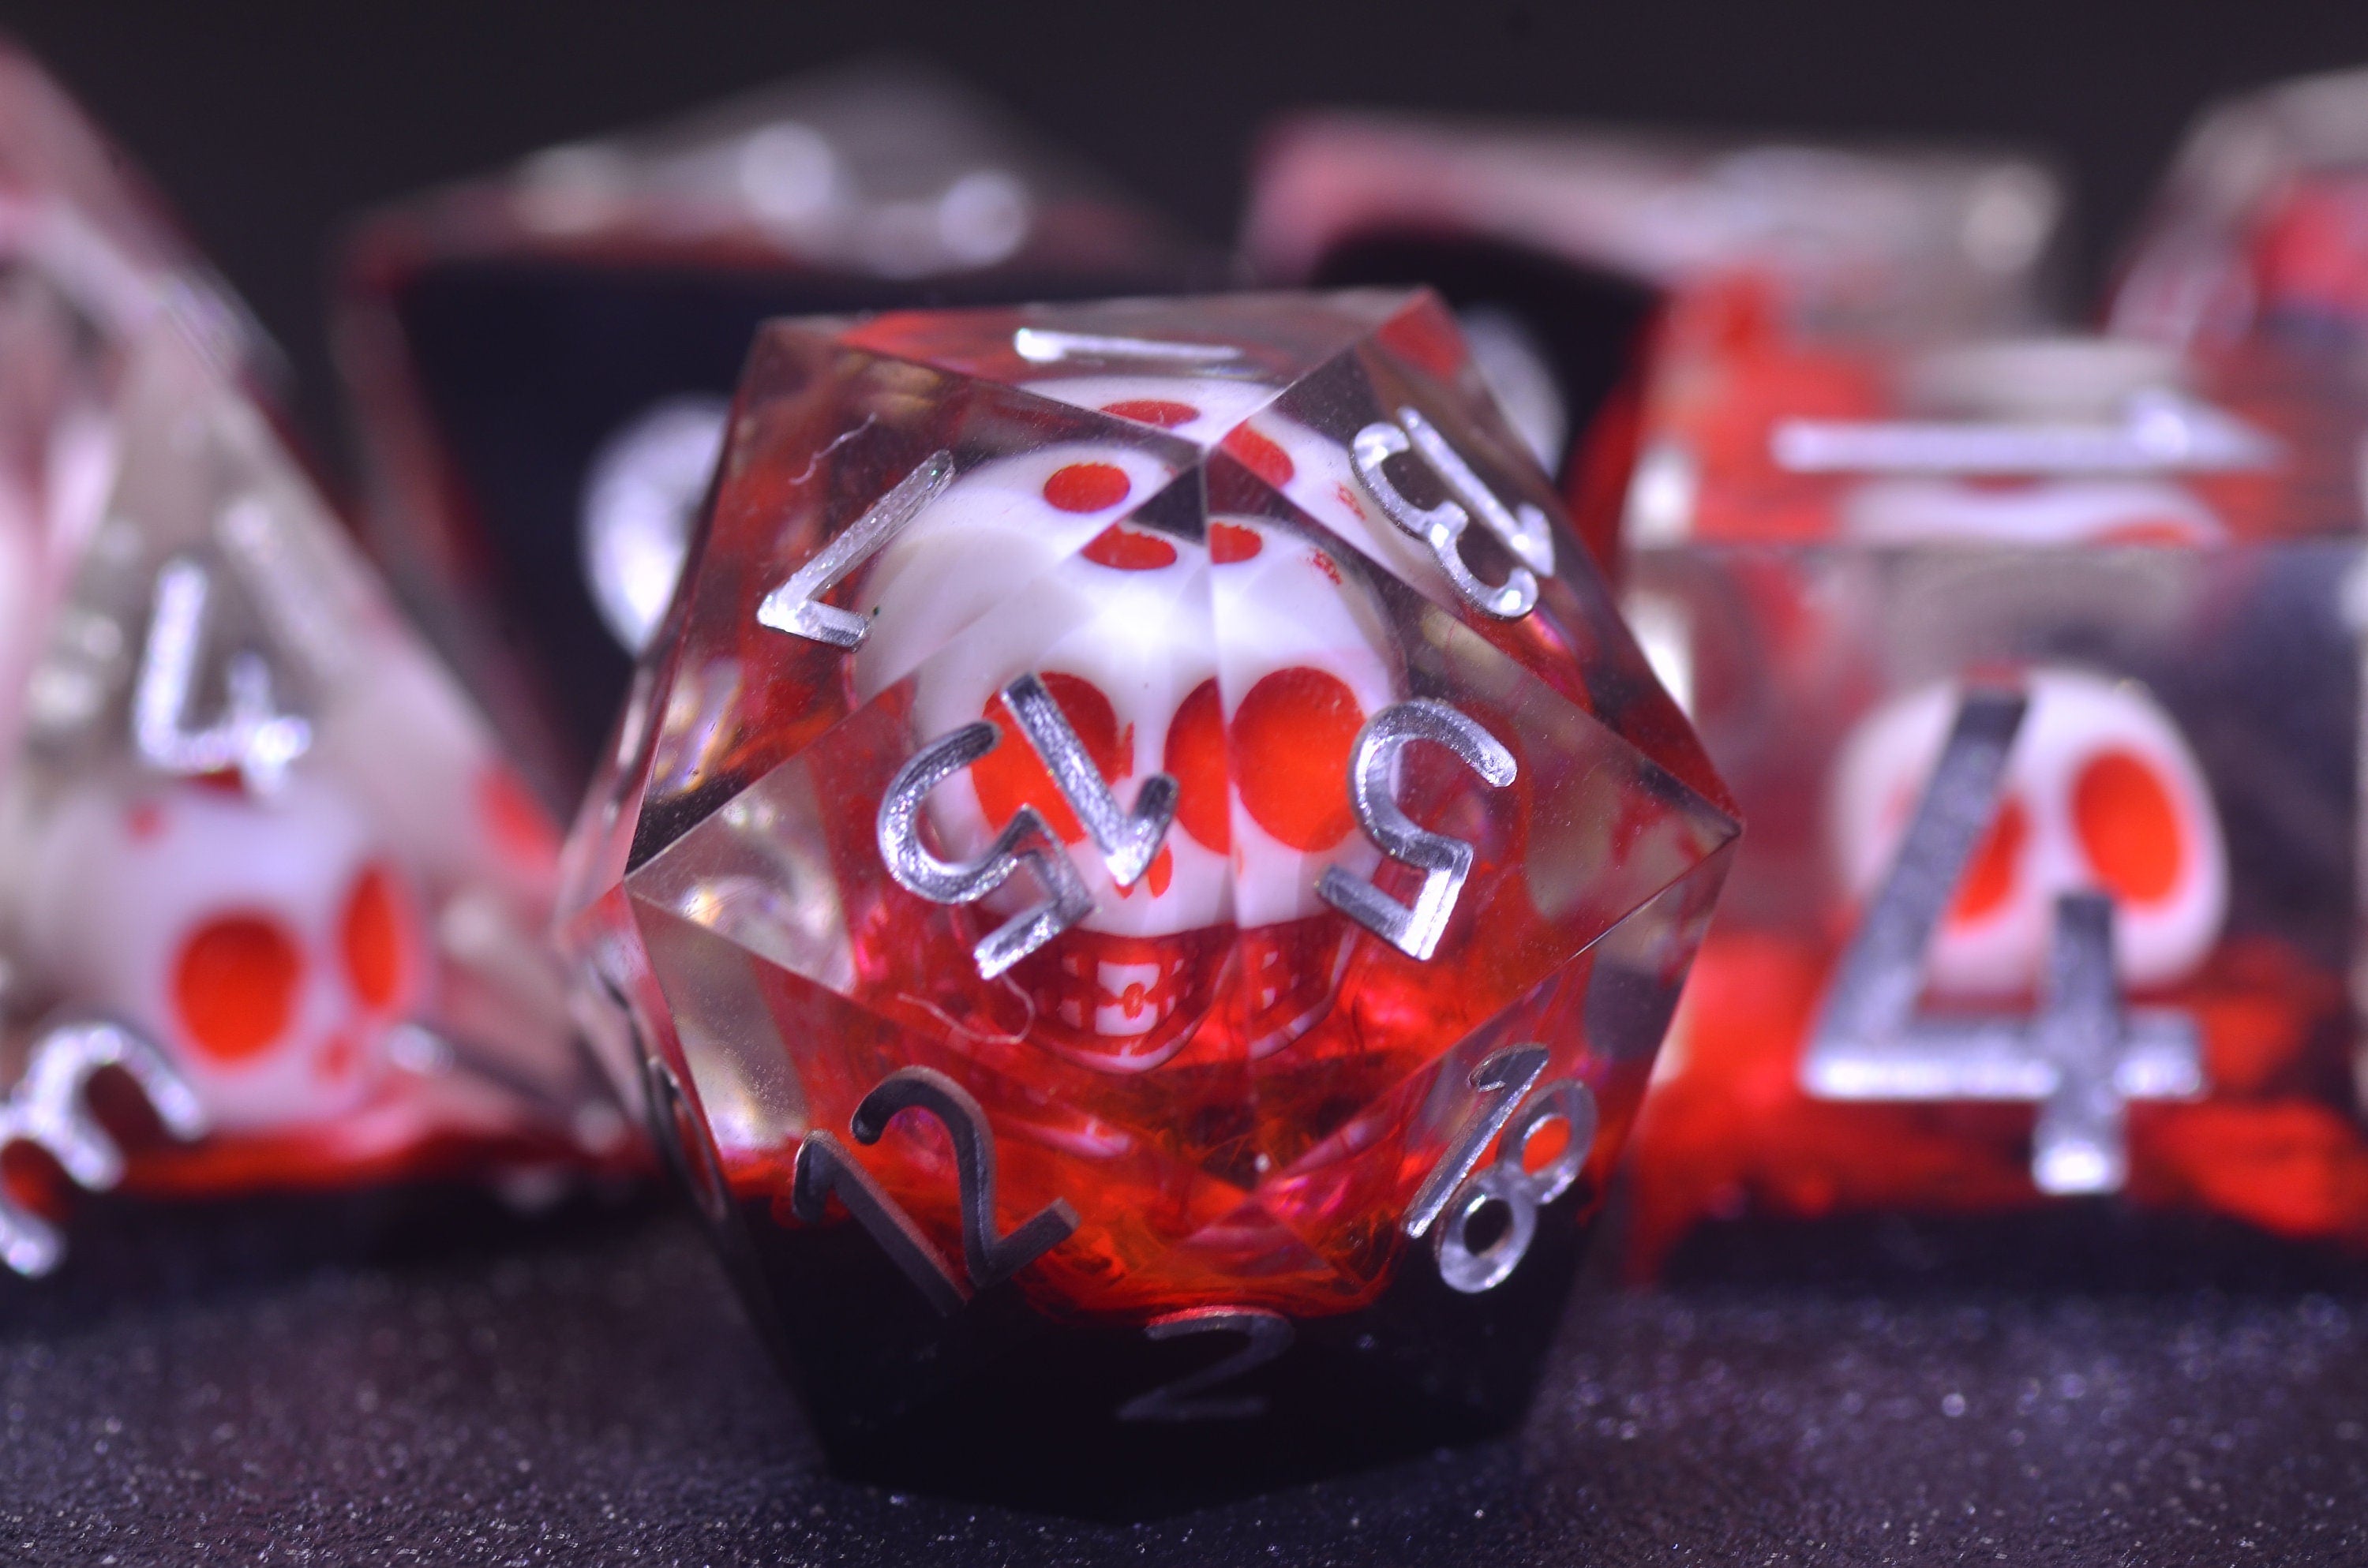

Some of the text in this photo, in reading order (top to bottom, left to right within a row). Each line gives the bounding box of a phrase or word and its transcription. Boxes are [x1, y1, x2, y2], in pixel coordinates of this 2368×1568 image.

[1348, 406, 1556, 620] 13
[132, 560, 311, 797] 4
[876, 672, 1179, 981] 15
[1314, 697, 1518, 962] 5
[1800, 687, 2206, 1196] 4
[792, 1065, 1081, 1319] 12
[1402, 1042, 1599, 1294] 18
[1116, 1304, 1296, 1421] 2
